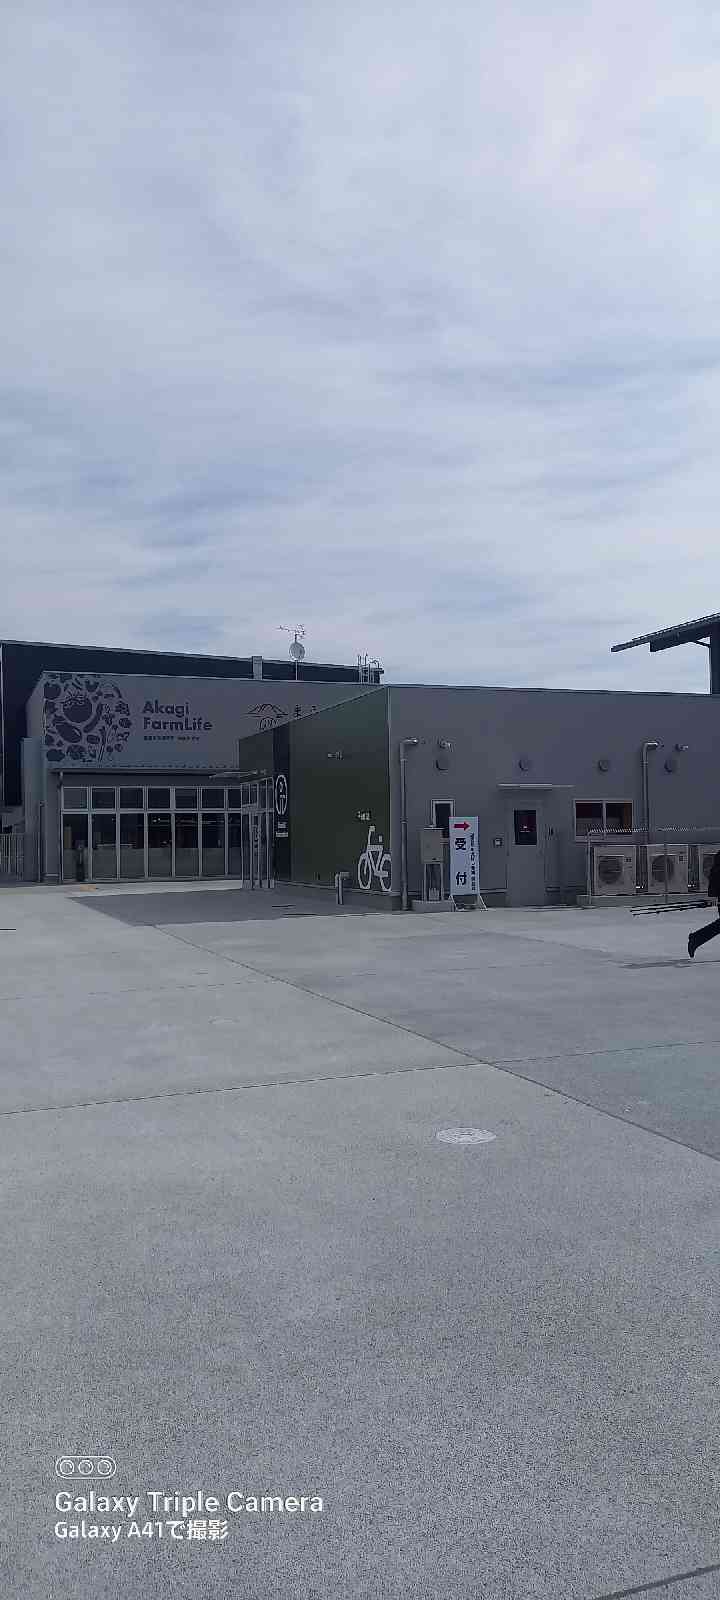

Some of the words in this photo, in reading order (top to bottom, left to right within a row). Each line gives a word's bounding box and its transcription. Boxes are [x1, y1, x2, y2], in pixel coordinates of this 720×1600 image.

[143, 700, 190, 718] Akagi
[143, 717, 213, 731] FarmLife
[455, 838, 467, 886] 受付
